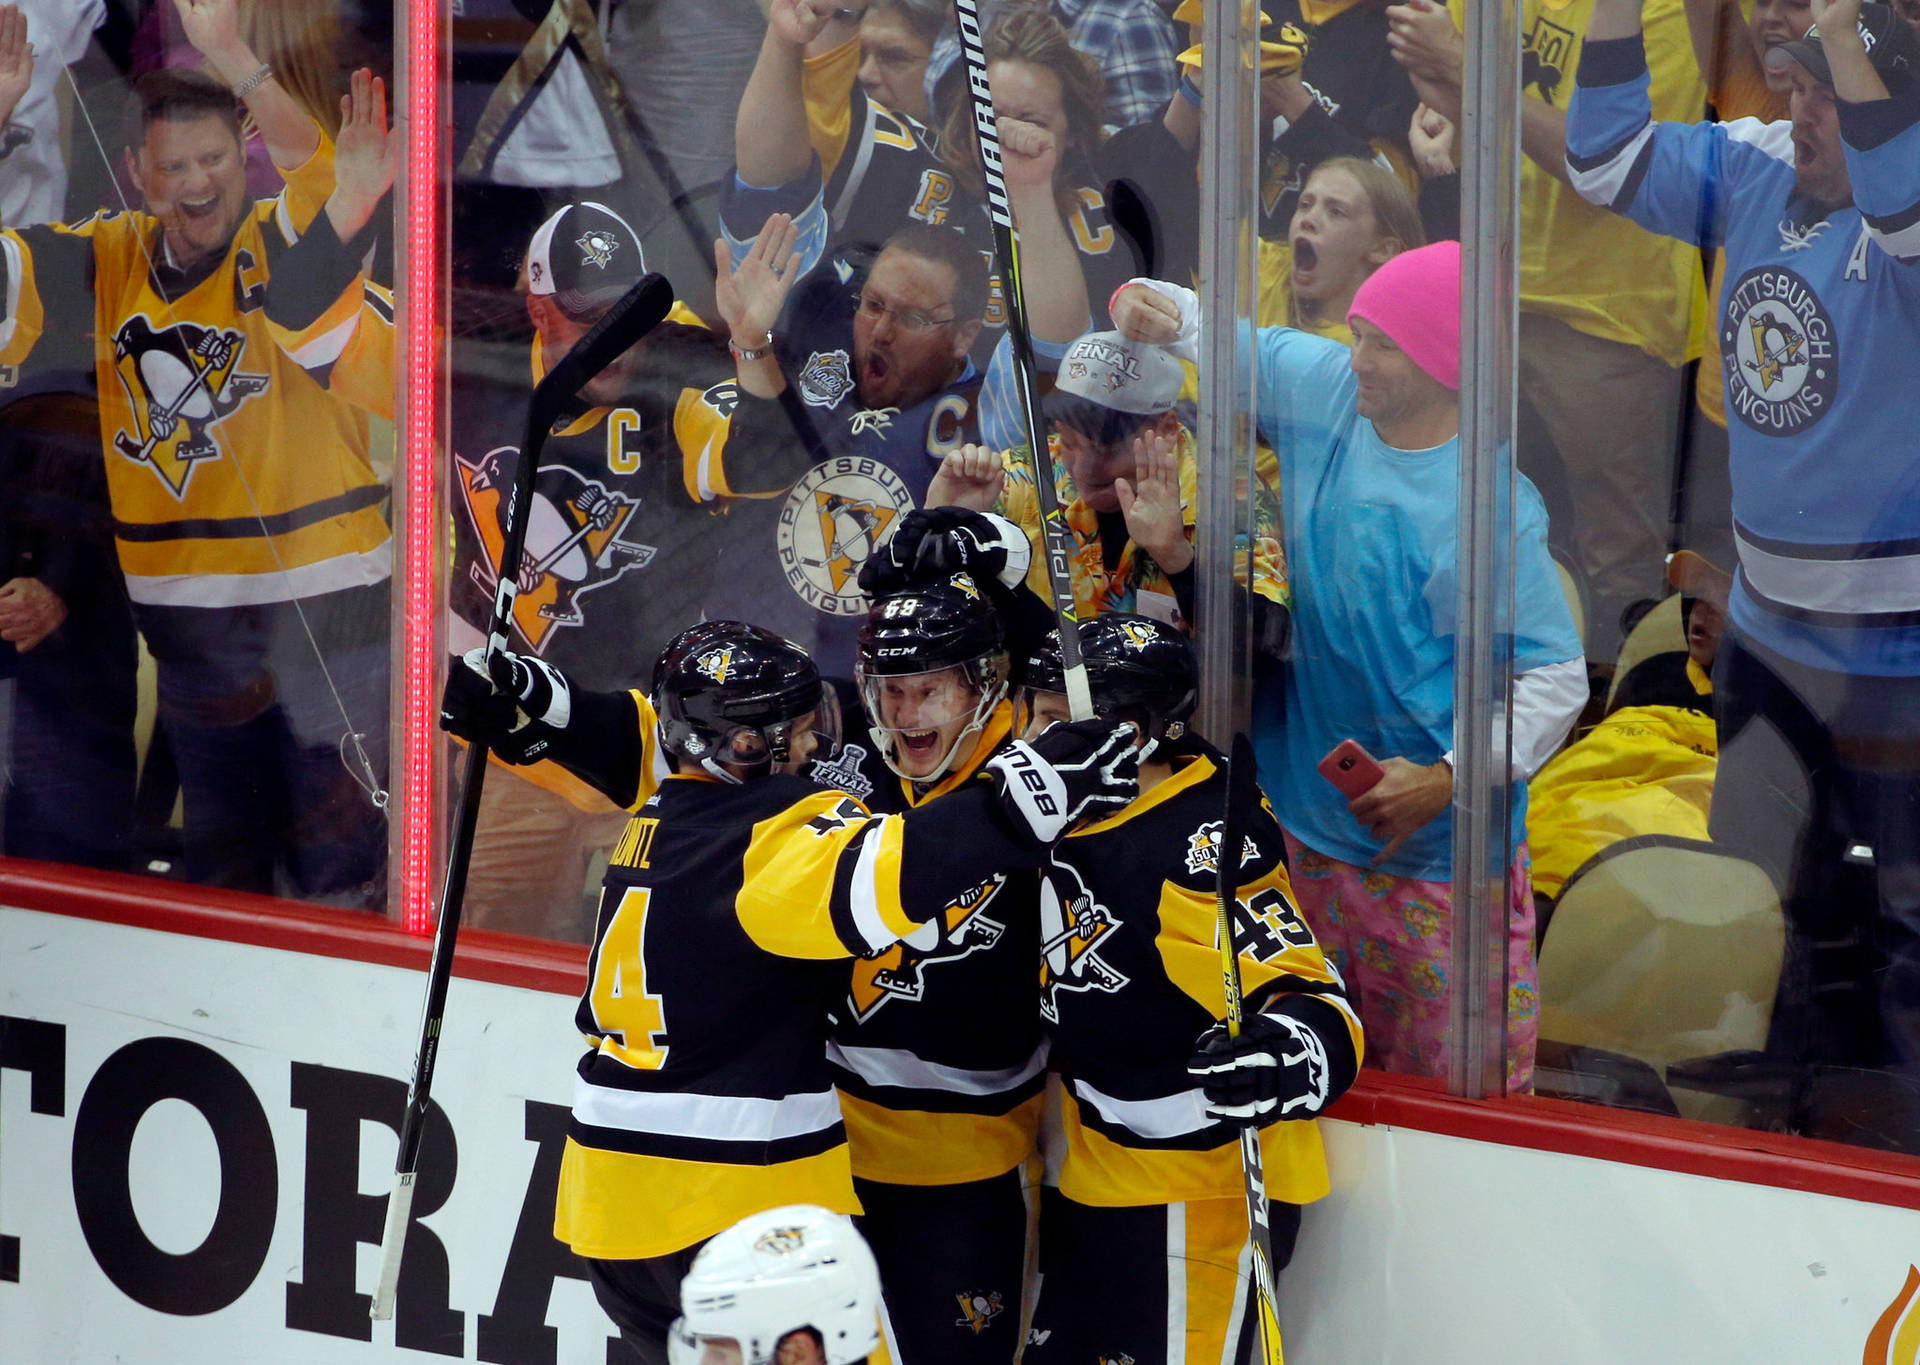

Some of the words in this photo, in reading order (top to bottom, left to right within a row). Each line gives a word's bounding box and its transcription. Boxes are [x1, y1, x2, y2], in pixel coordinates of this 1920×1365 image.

[956, 0, 1012, 228] WARRIO
[1069, 187, 1115, 255] C
[1843, 228, 1869, 281] A
[235, 248, 267, 315] C
[1728, 272, 1831, 359] PITTSBURGH
[1070, 342, 1141, 380] FINAL
[1726, 353, 1822, 428] PENGUINS
[608, 408, 640, 475] C
[926, 395, 969, 459] C
[781, 458, 910, 525] PITTSBUR
[784, 547, 872, 614] PENGU
[877, 646, 917, 656] CCM
[819, 768, 868, 793] FINAL
[1195, 850, 1211, 863] 50
[1214, 887, 1316, 963] 43
